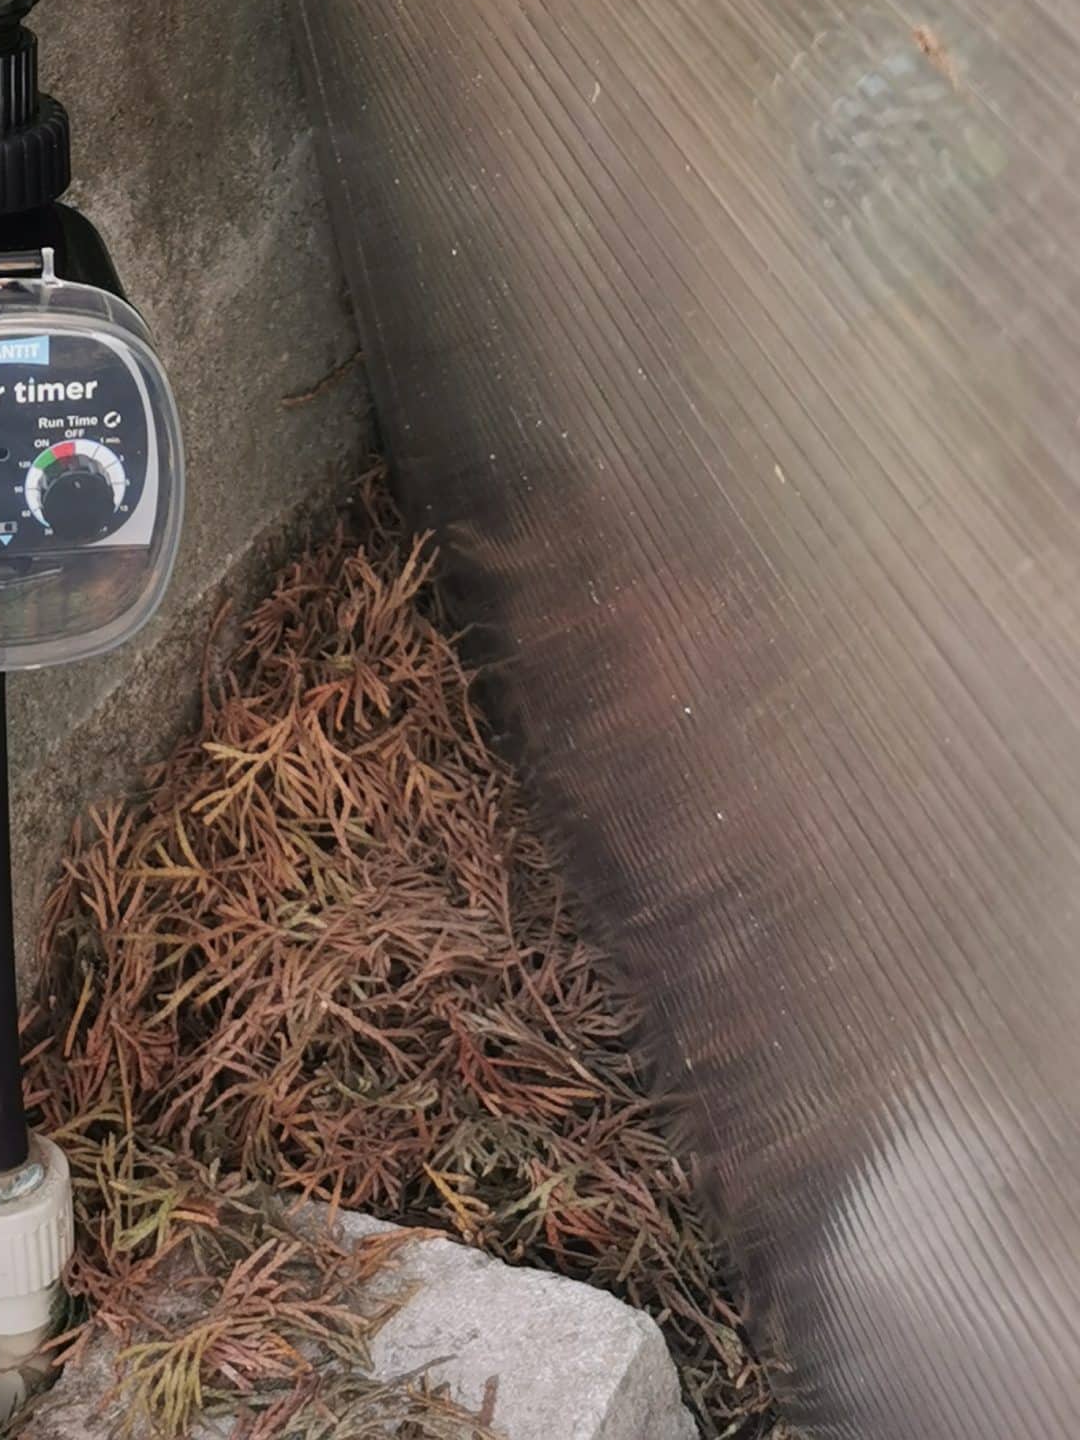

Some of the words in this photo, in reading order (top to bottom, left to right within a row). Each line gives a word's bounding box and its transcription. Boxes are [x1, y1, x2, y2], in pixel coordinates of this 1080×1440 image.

[14, 376, 98, 404] timer
[38, 417, 64, 429] Run
[67, 415, 98, 427] Time
[64, 428, 85, 438] OFF
[33, 439, 50, 449] ON
